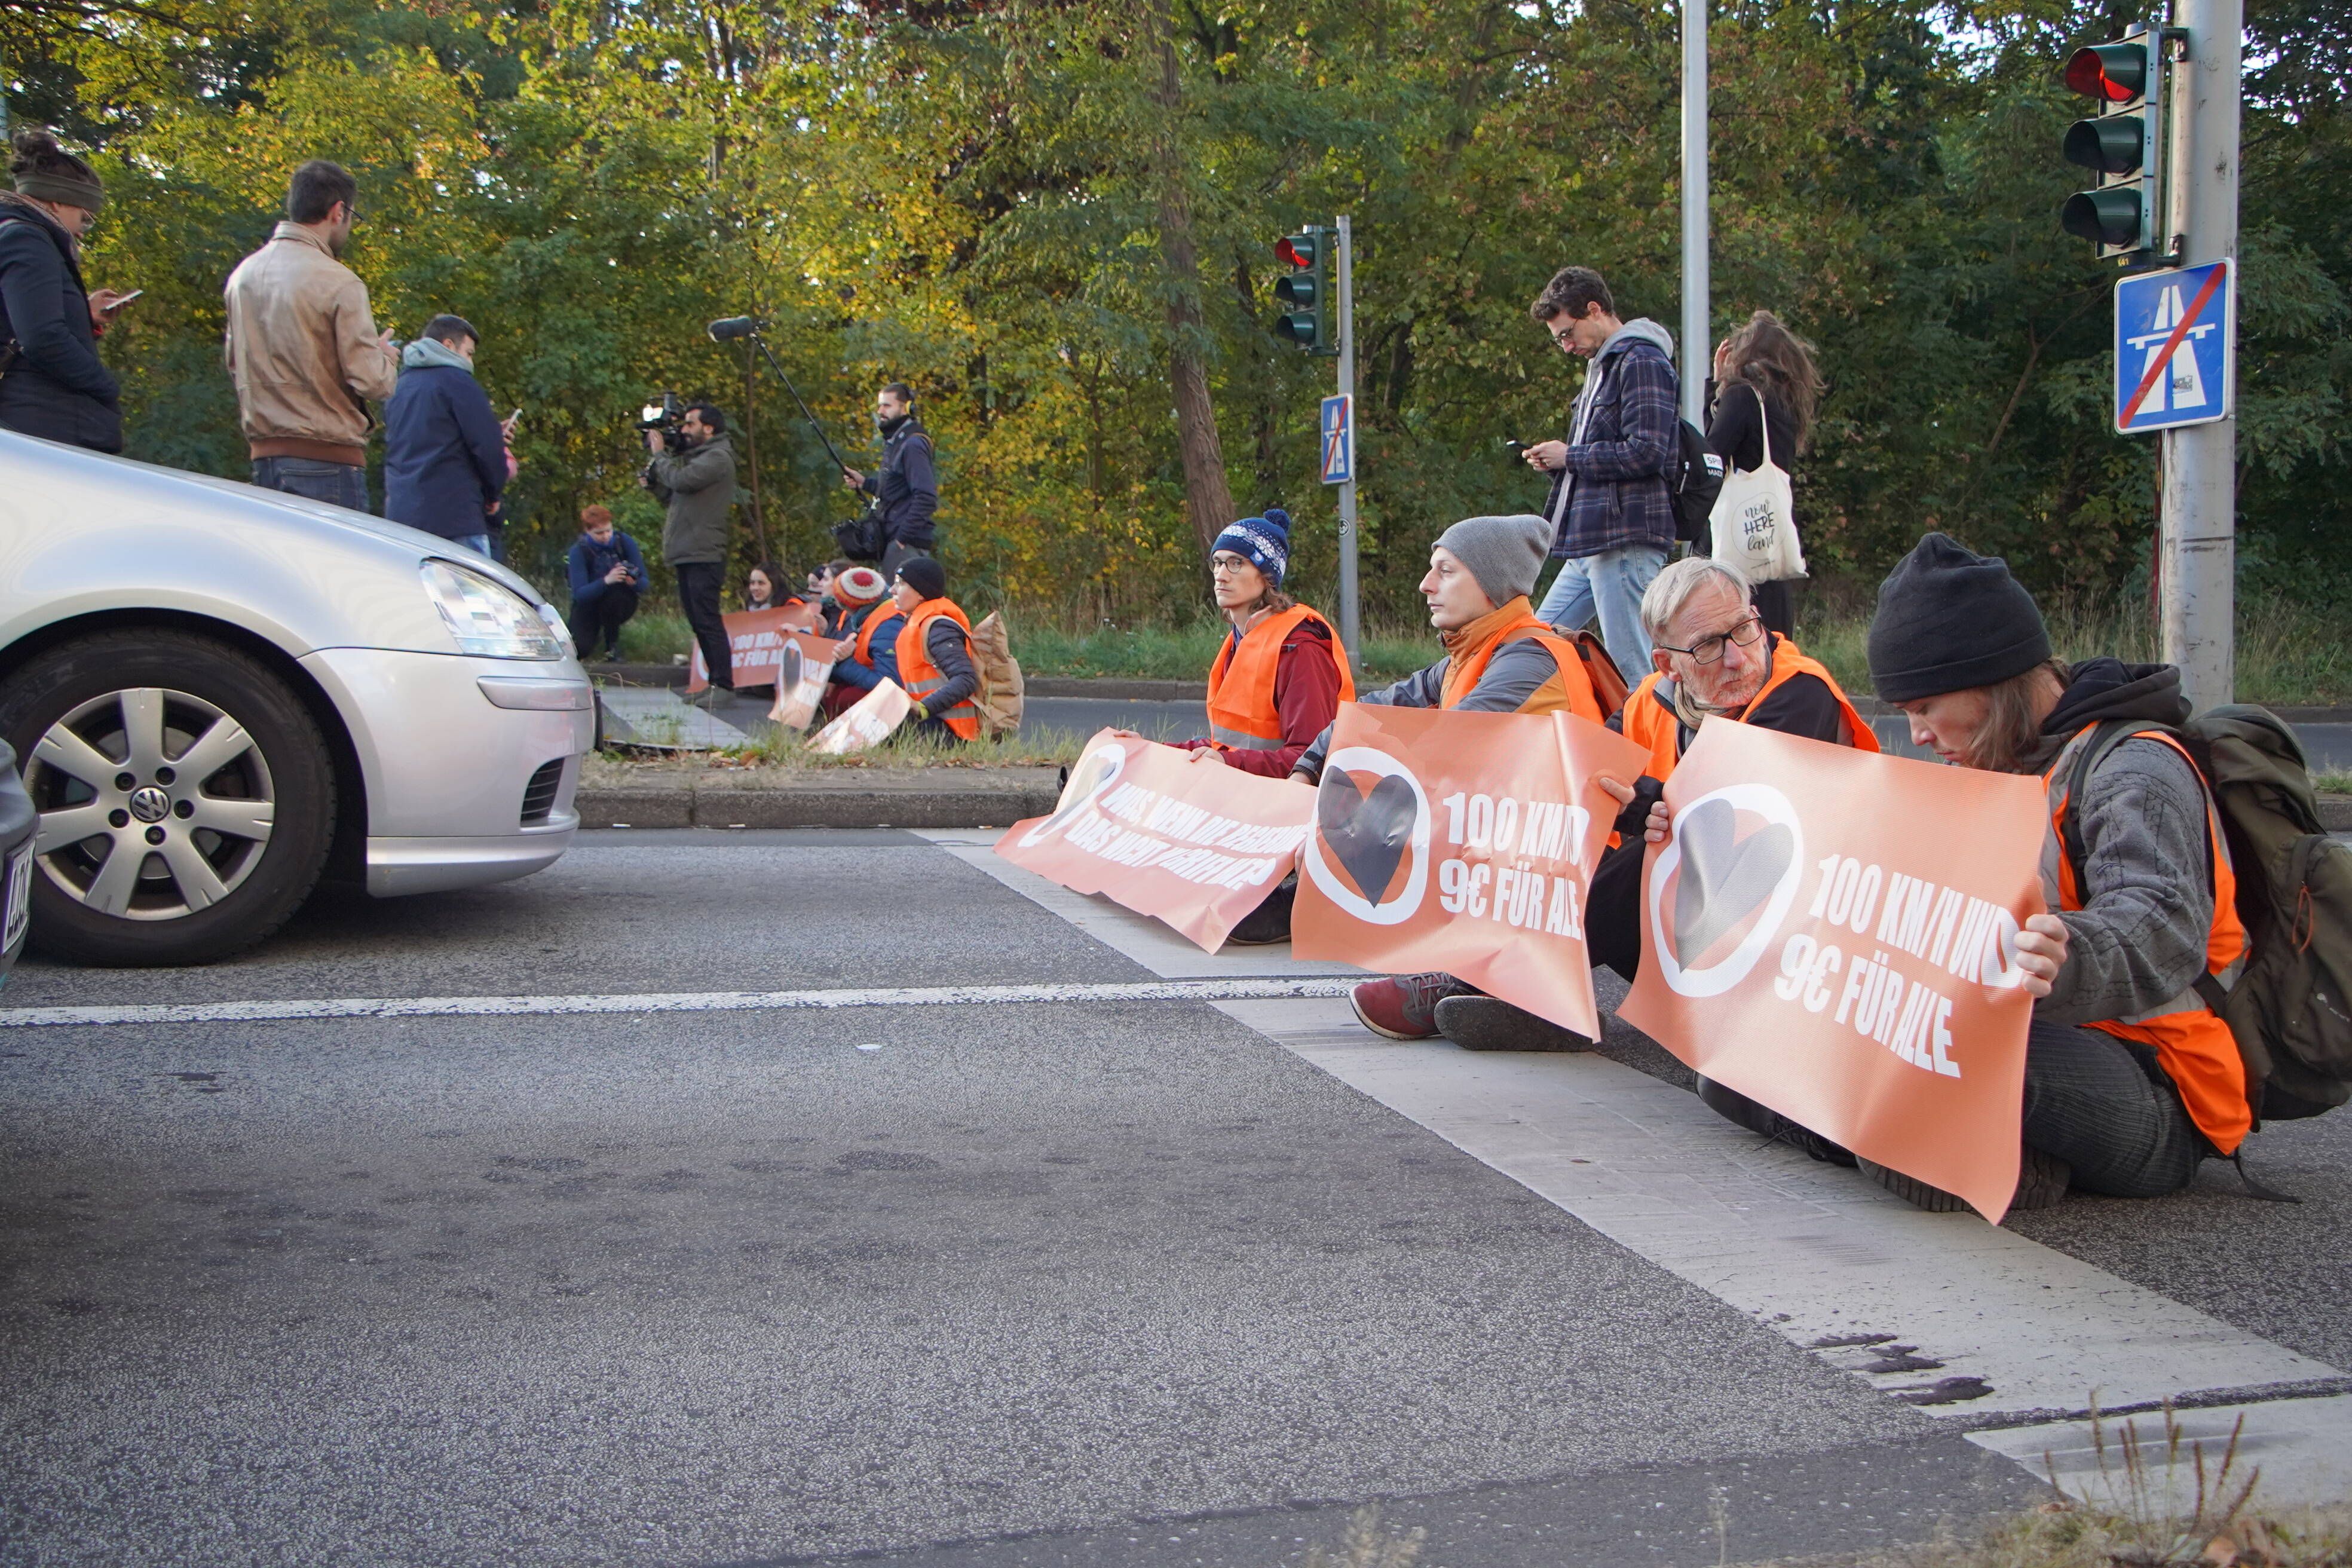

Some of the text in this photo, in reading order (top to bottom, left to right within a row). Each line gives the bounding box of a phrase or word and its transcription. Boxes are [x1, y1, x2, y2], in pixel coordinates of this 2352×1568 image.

[1744, 512, 1775, 535] HERE
[1747, 528, 1775, 550] land
[1063, 810, 1122, 853] DAS
[1097, 830, 1172, 867] NICHT
[1143, 795, 1211, 841] WENN
[1186, 815, 1241, 846] DIE
[1443, 792, 1518, 852] 100
[1439, 858, 1491, 918] 9€
[1492, 860, 1545, 930] FÜR
[1809, 853, 2024, 989] 100 KM/H UND
[1774, 933, 1961, 1079] 9€ FÜR ALLE
